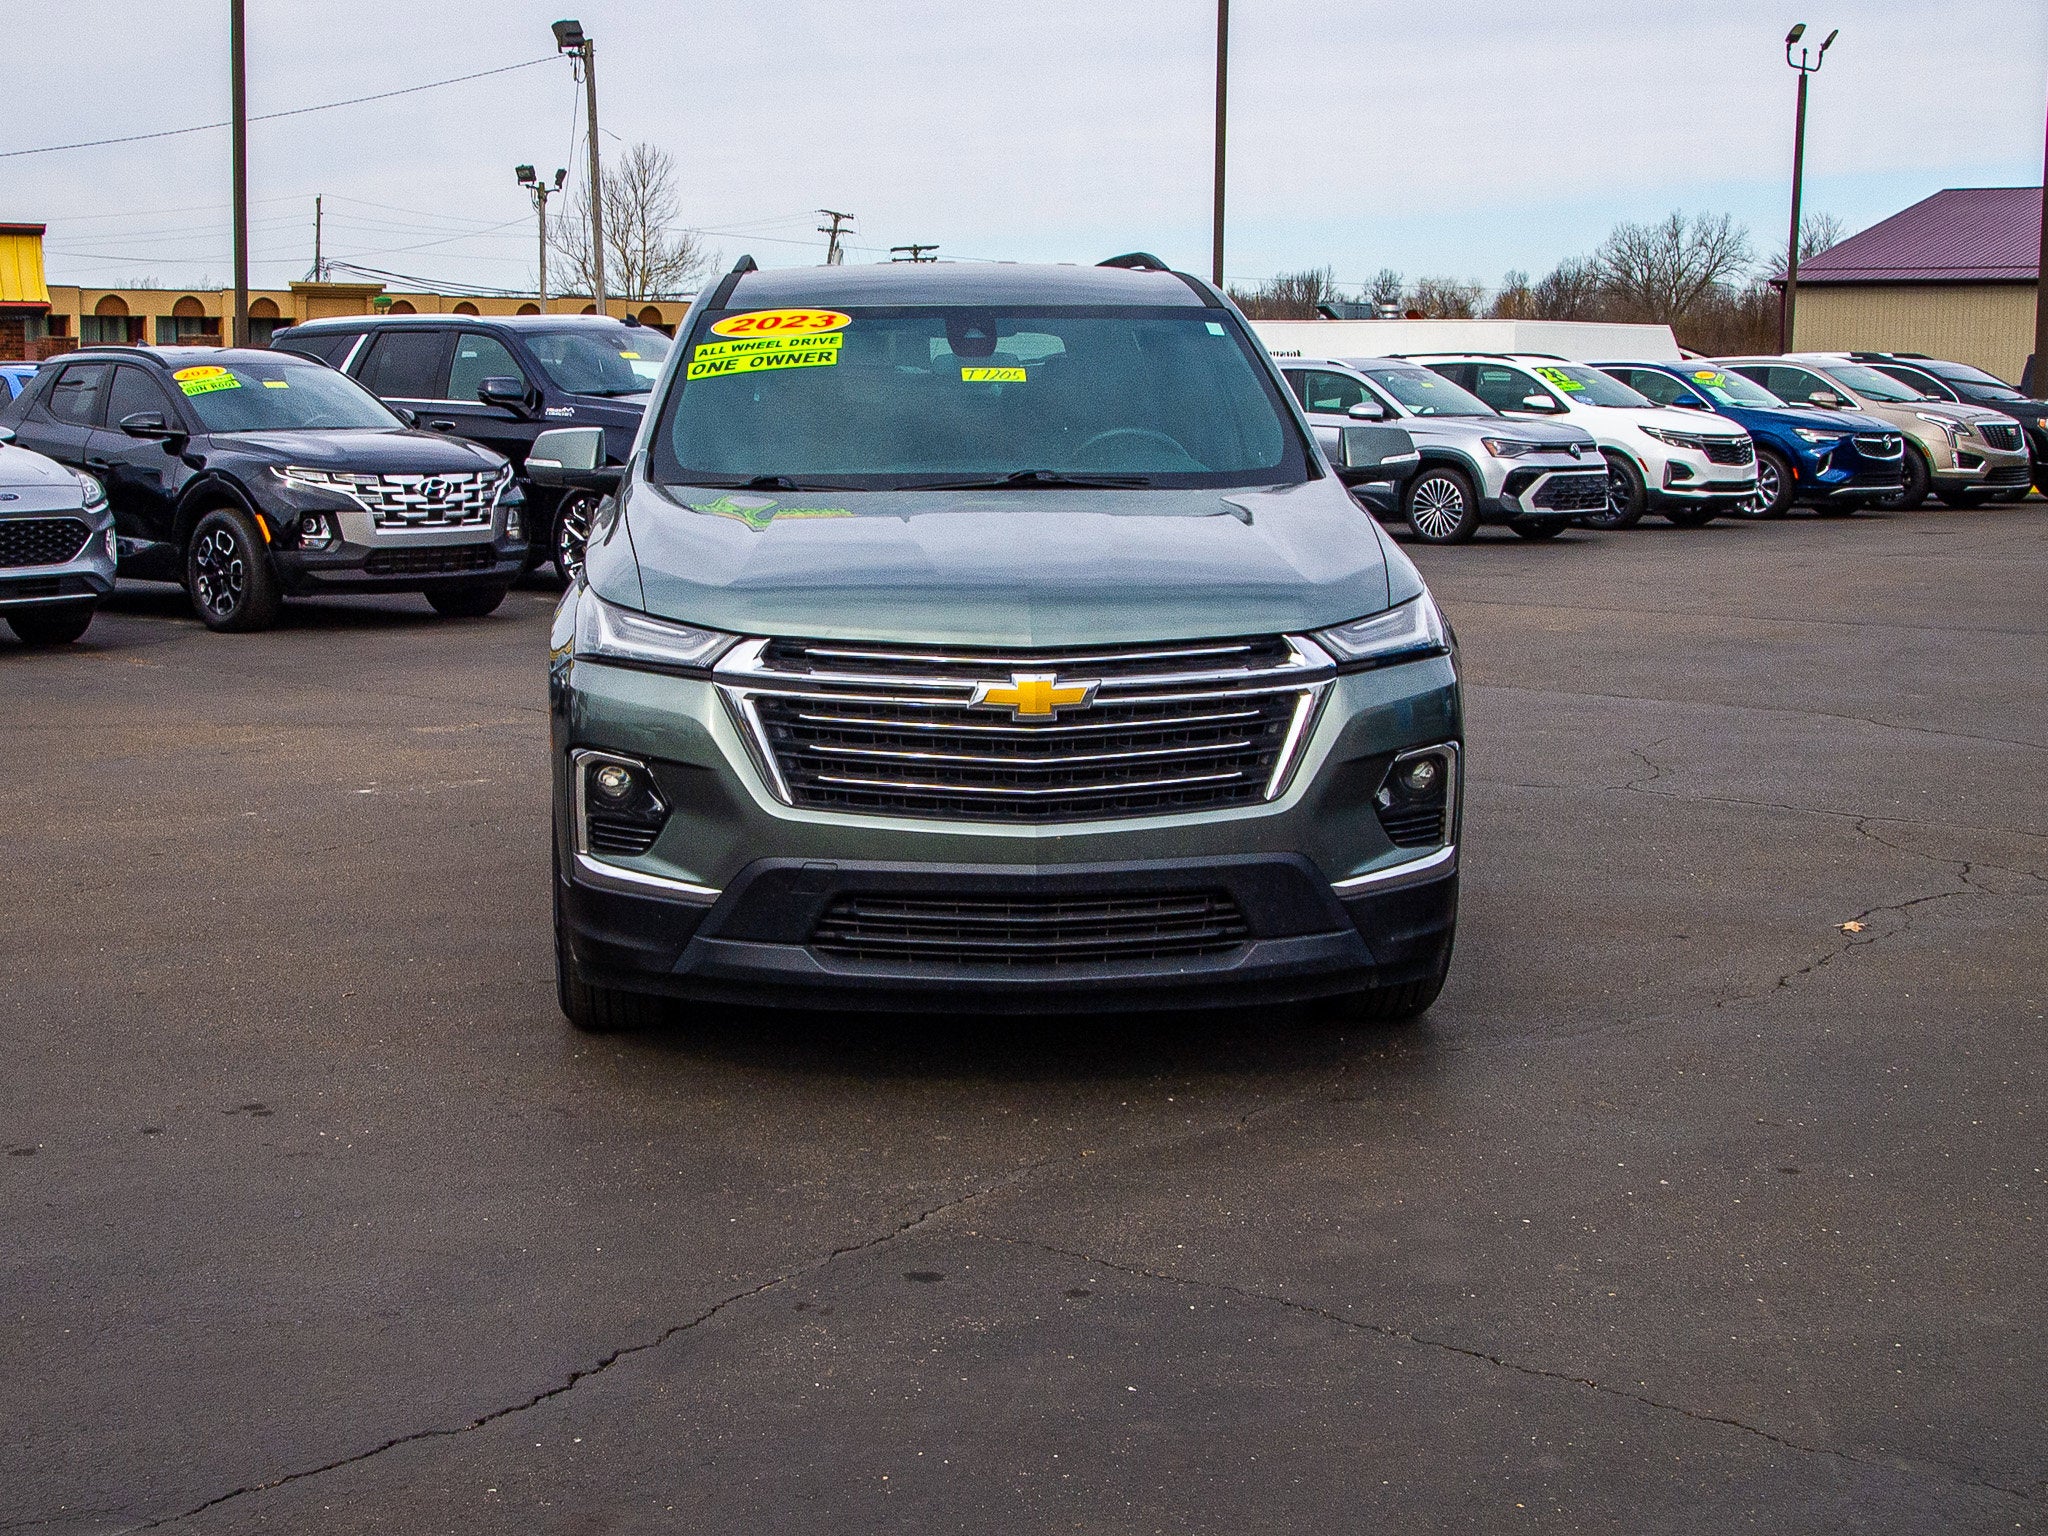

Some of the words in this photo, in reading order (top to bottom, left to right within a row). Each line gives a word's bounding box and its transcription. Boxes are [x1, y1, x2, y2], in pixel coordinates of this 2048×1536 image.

[727, 314, 837, 333] 2023
[699, 346, 727, 358] ALL
[731, 340, 783, 352] WHEEL
[789, 336, 840, 347] DRIVE
[692, 359, 740, 375] ONE
[749, 351, 833, 367] OWNER
